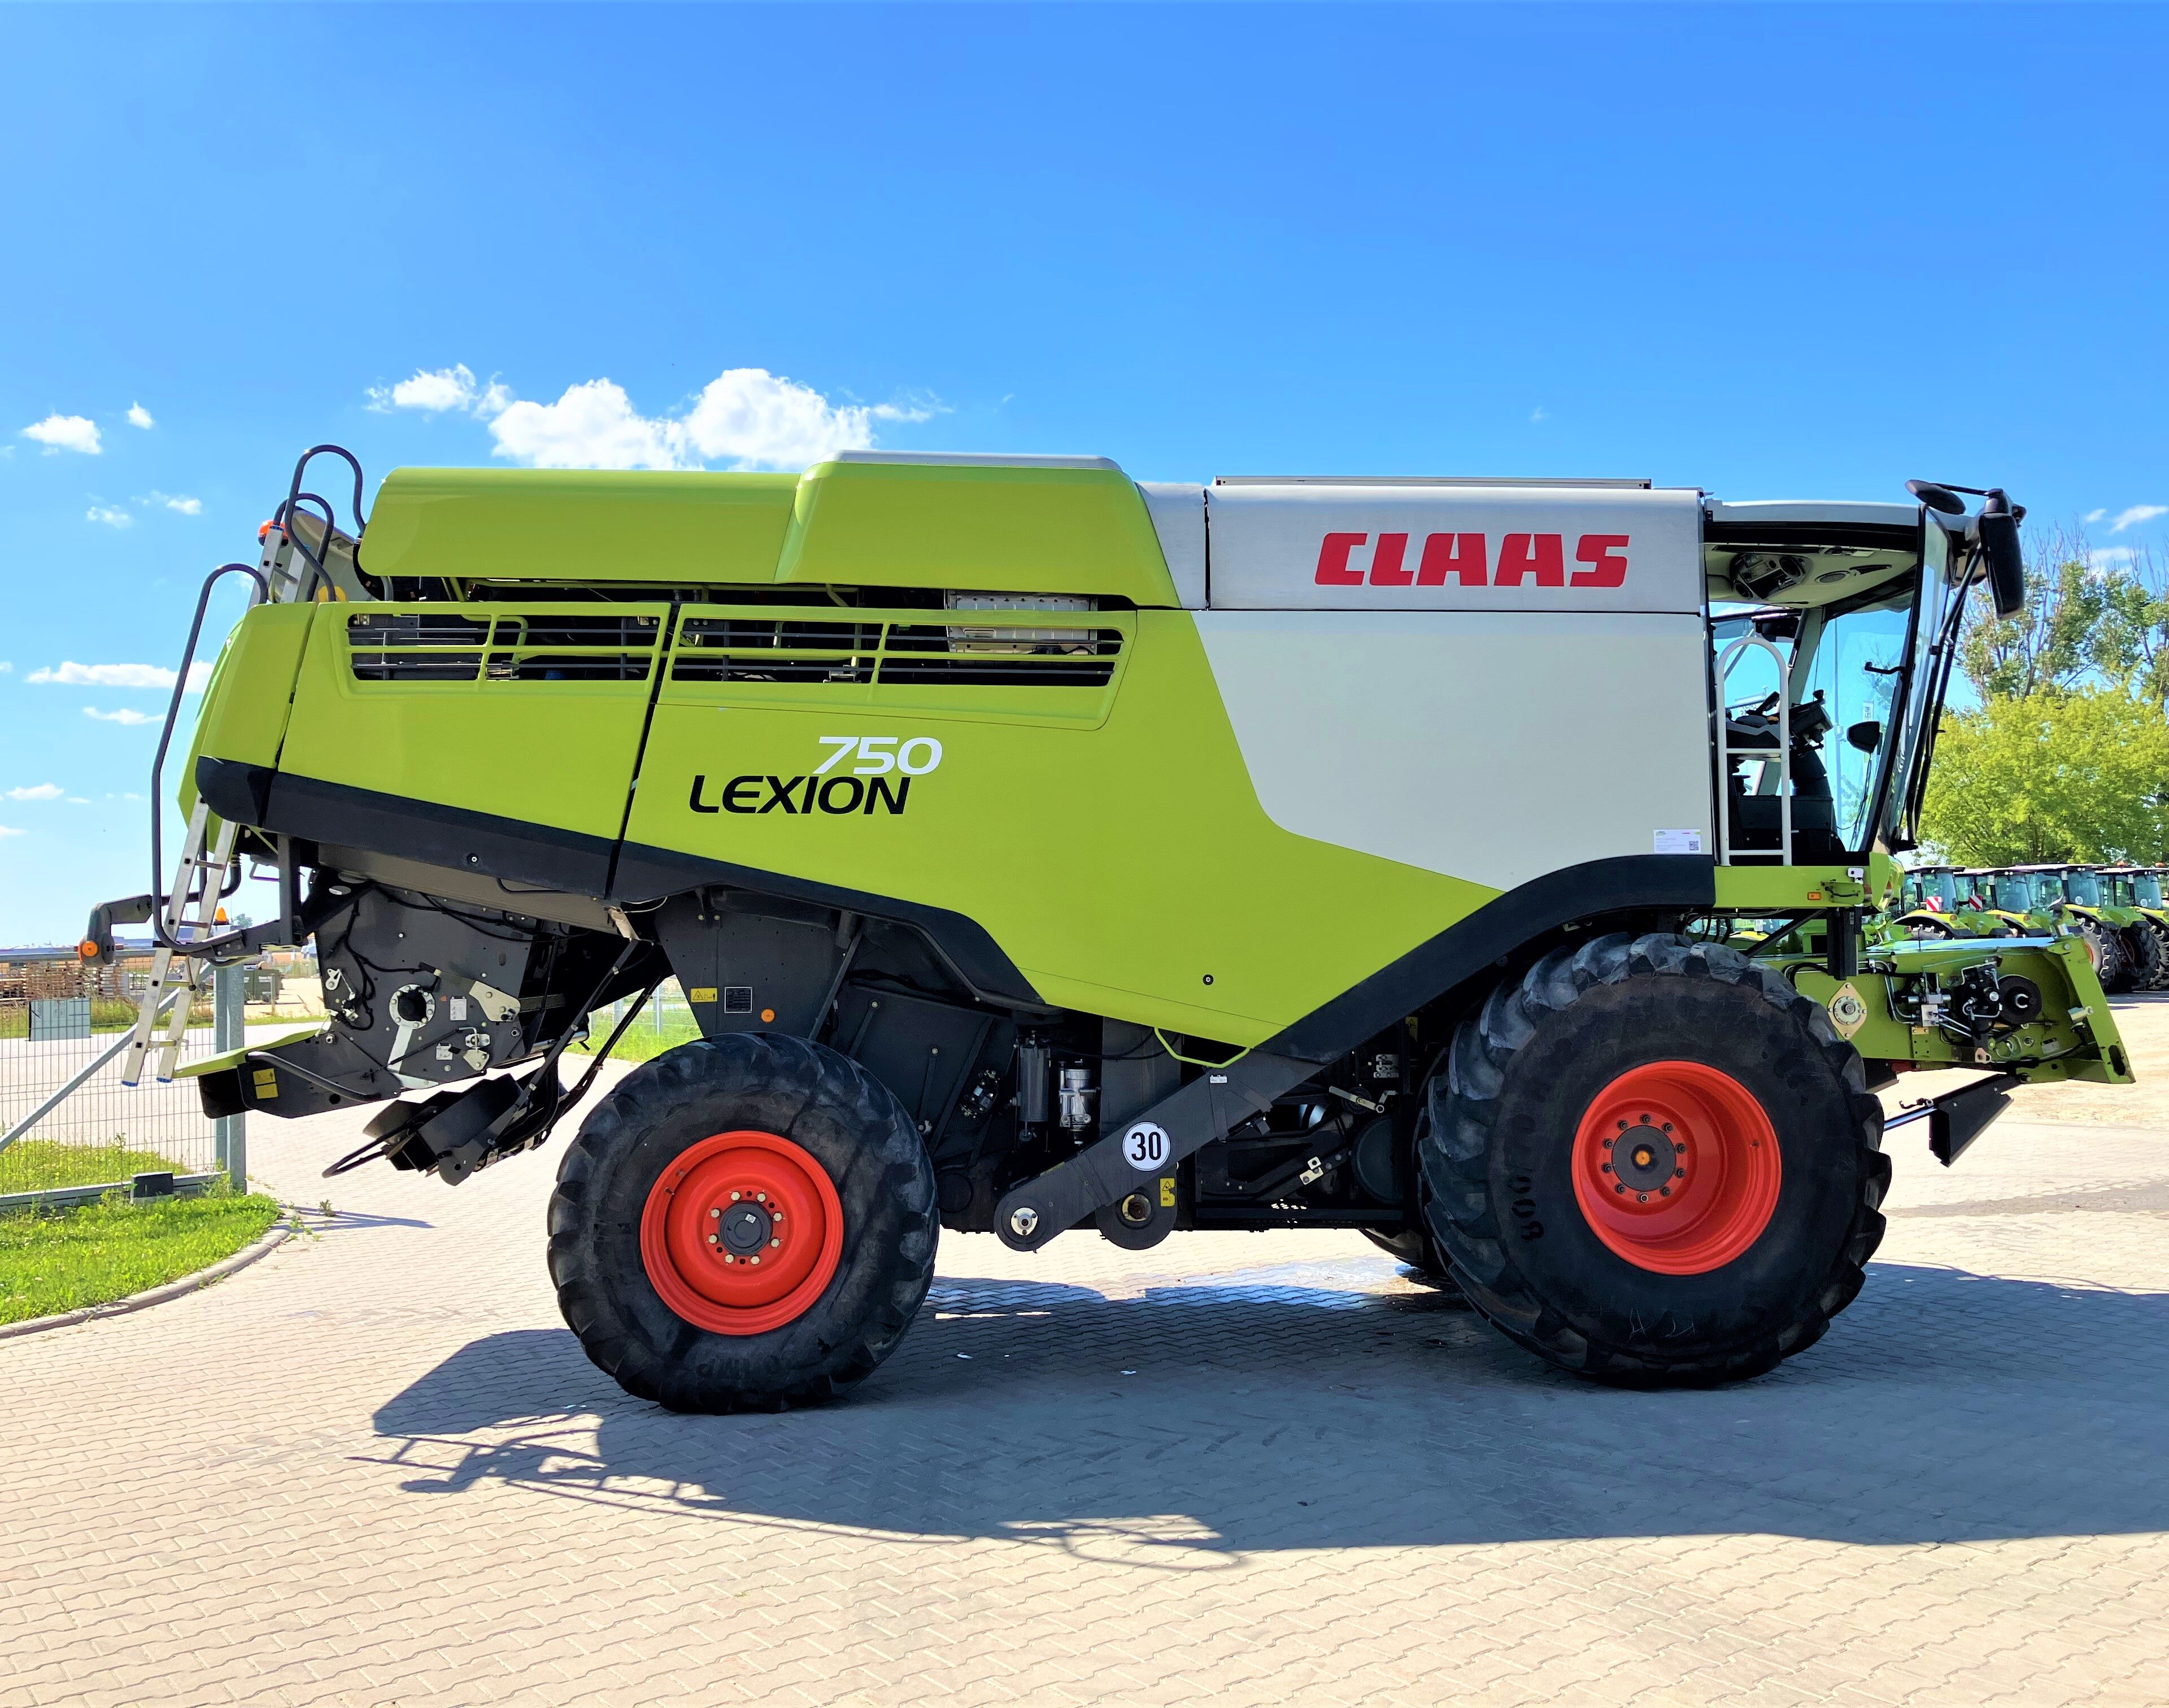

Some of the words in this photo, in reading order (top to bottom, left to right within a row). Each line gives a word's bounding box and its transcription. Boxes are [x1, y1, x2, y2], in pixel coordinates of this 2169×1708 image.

[1315, 533, 1630, 587] CLAAS
[812, 736, 943, 775] 750
[689, 775, 911, 814] LEXION
[1131, 1131, 1161, 1161] 30
